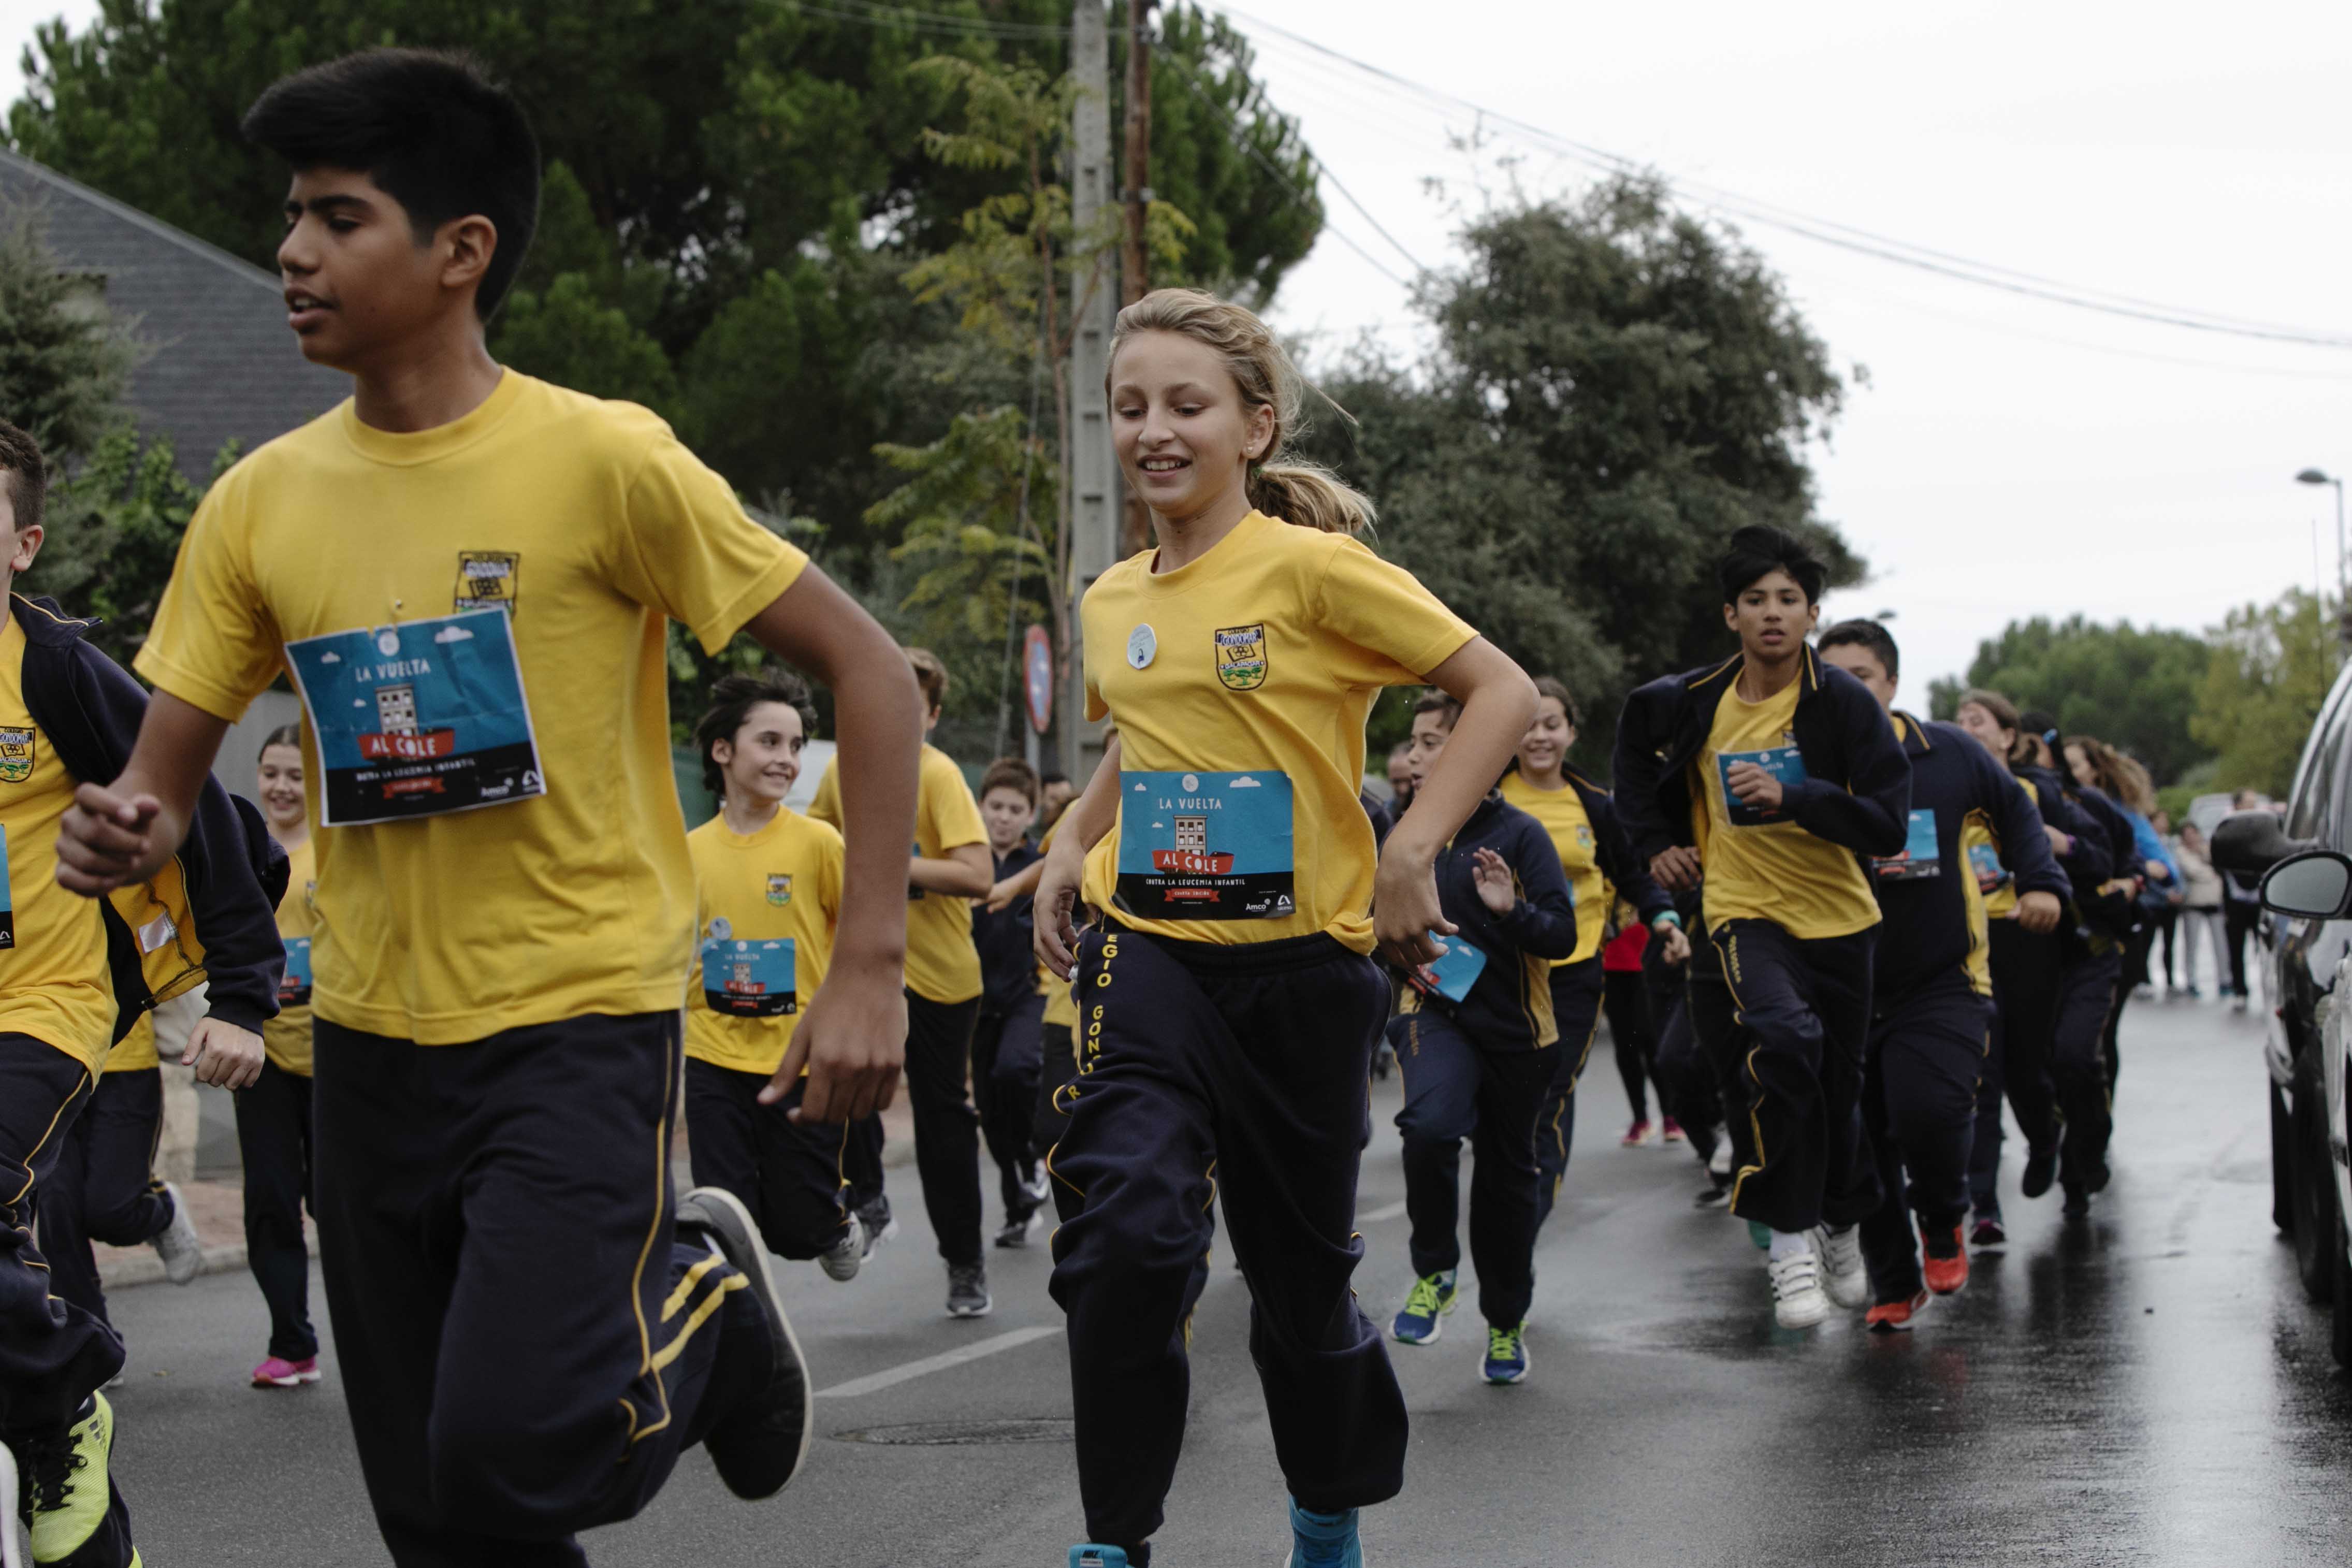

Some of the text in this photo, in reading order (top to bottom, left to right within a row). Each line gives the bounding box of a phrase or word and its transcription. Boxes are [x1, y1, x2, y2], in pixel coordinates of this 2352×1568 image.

[1224, 633, 1258, 645] GONDOMAR
[355, 658, 431, 682] LA VUELTA
[372, 737, 437, 756] AL COLE
[1159, 798, 1222, 809] LA VUELTA
[1163, 852, 1217, 872] AL COLE
